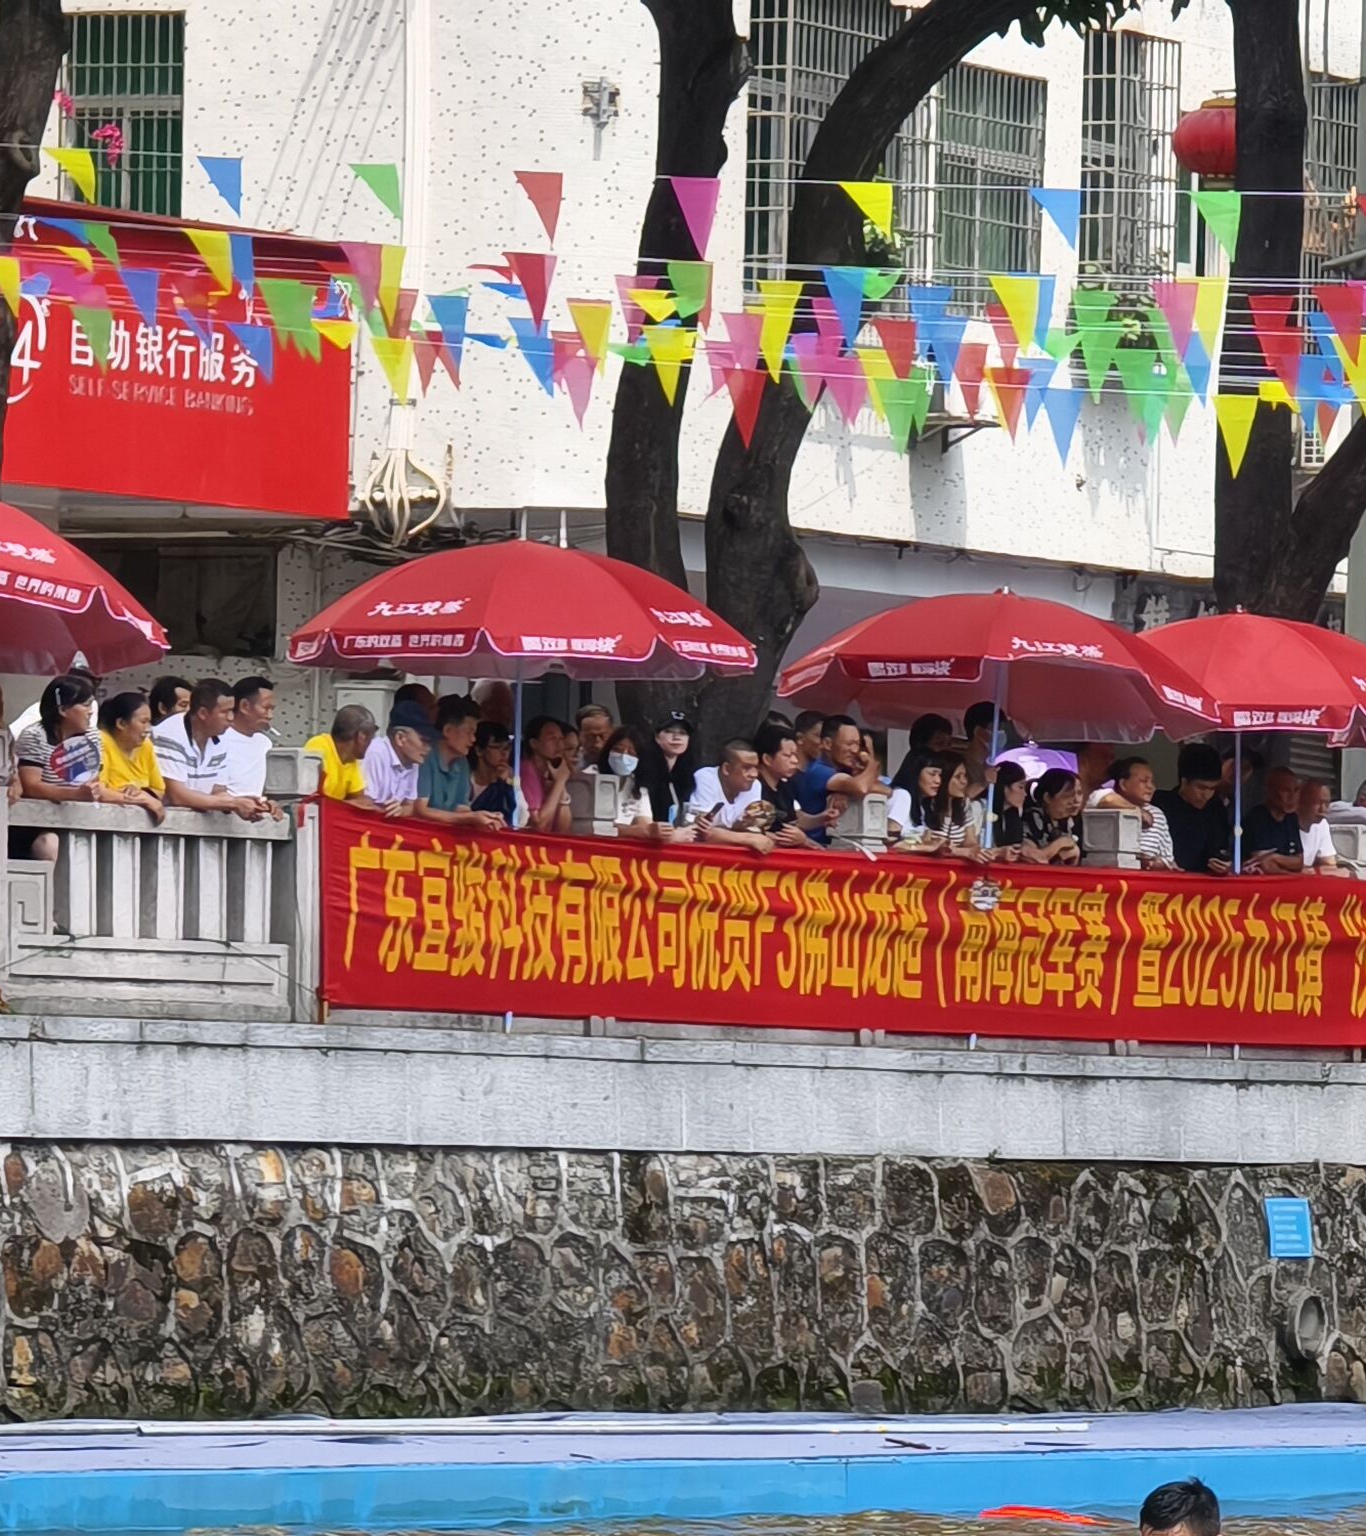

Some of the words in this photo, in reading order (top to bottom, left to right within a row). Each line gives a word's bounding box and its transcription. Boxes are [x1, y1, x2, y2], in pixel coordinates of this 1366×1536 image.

[69, 317, 259, 389] 自助银行服务
[184, 387, 255, 417] BANKING
